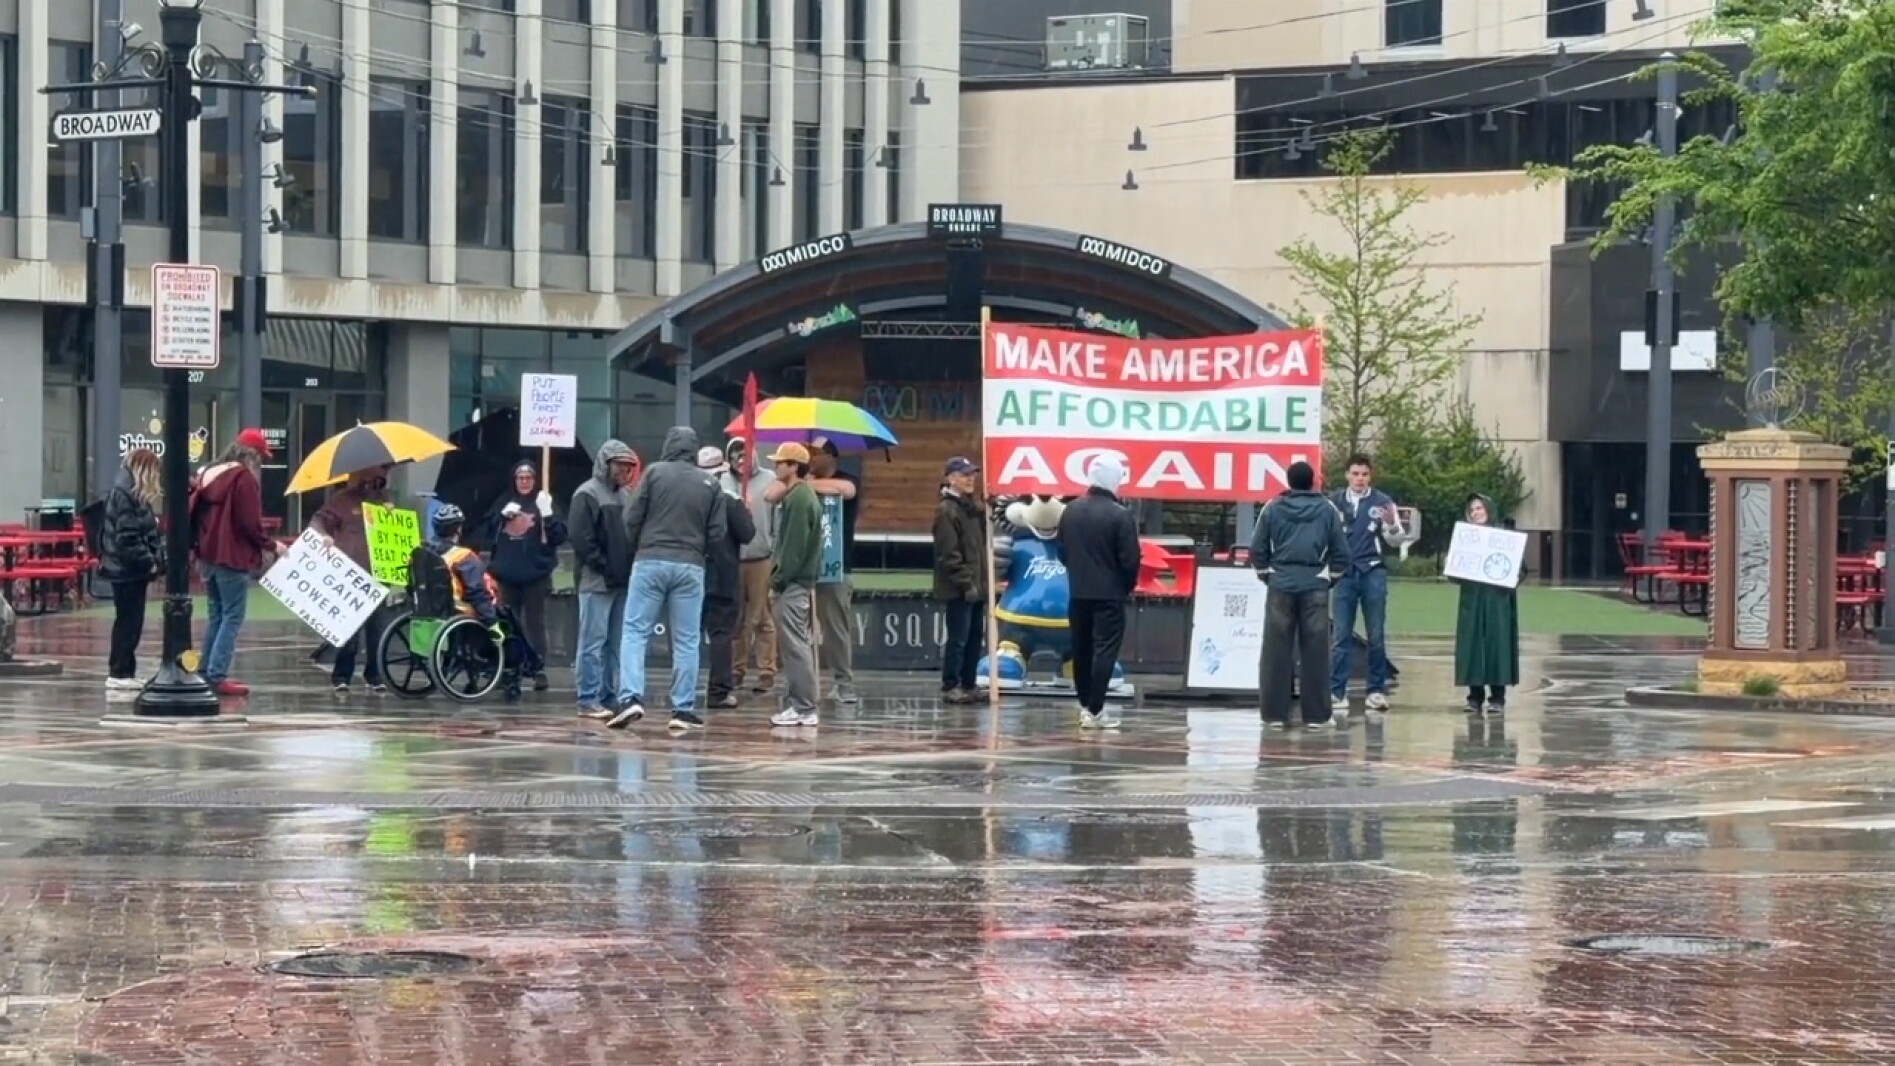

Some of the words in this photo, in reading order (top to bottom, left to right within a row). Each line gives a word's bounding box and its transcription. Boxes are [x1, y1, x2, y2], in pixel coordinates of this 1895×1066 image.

[61, 112, 153, 136] BROADWAY
[933, 208, 996, 223] BROADWAY
[785, 235, 846, 266] MIDCO
[1105, 244, 1164, 276] MIDCO
[160, 271, 211, 283] PROHIBITED
[995, 332, 1107, 380] MAKE
[1119, 340, 1309, 382] AMERICA
[532, 375, 557, 388] PUT
[996, 389, 1308, 434] AFFORDABLE
[374, 548, 396, 562] SEAT
[377, 530, 390, 546] BY
[394, 533, 414, 549] THE
[297, 551, 317, 572] TO
[322, 573, 365, 612] GAIN
[302, 531, 344, 570] USING
[344, 567, 382, 604] FEAR
[261, 577, 283, 598] THIS
[285, 597, 296, 608] IS
[299, 608, 341, 645] FASCISM
[884, 612, 949, 648] SQU
